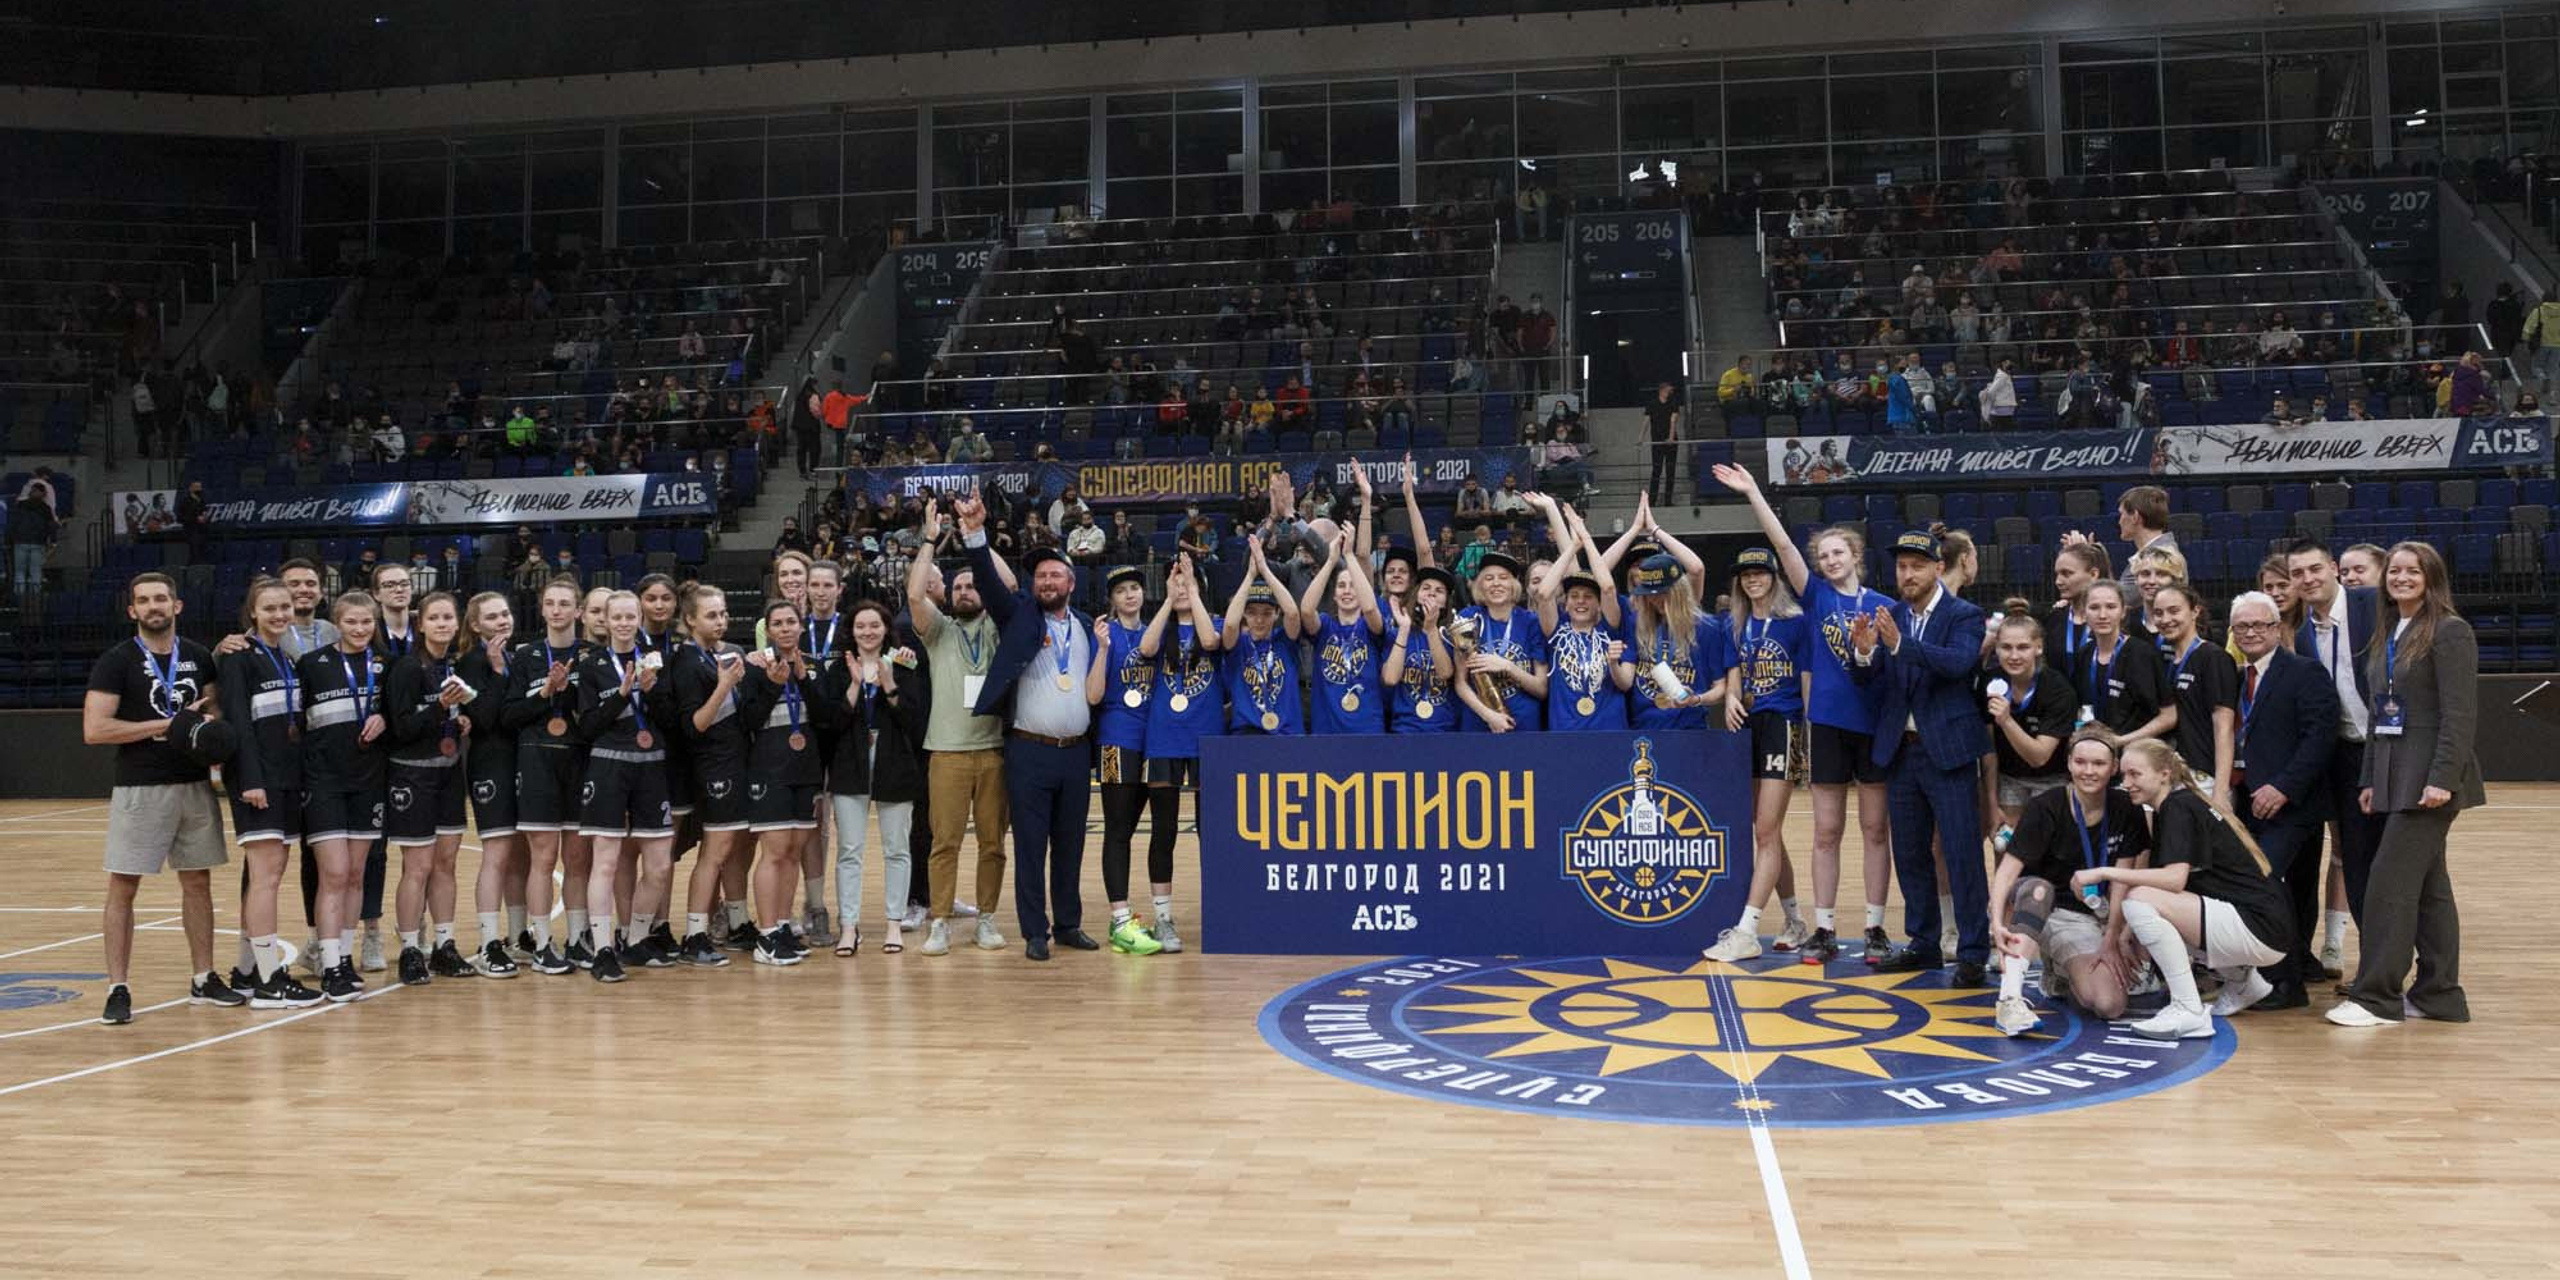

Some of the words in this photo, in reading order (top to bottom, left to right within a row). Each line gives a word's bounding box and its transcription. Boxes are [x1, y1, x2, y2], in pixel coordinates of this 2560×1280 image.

[2389, 191, 2430, 211] 207
[1582, 223, 1619, 242] 205
[1636, 221, 1673, 240] 206
[902, 254, 937, 272] 204
[1436, 459, 1471, 481] 2021
[1858, 448, 1953, 476] ЛЕГЕНДА
[1080, 462, 1232, 498] СУПЕРФИНАЛ
[1765, 754, 1786, 771] 14
[1237, 770, 1536, 850] ЧЕМПИОН
[1573, 838, 1717, 867] СУПЕРФИНАЛ
[1267, 864, 1419, 894] БЕЛГОРОД
[1440, 863, 1506, 891] 2021
[1615, 882, 1678, 900] БЕЛГОРОД
[1352, 904, 1418, 931] АСБ
[1357, 958, 1481, 986] 2021
[1304, 1004, 1607, 1106] СУПЕРФИНАЛ
[1883, 1052, 2159, 1110] БЕЛОВА
